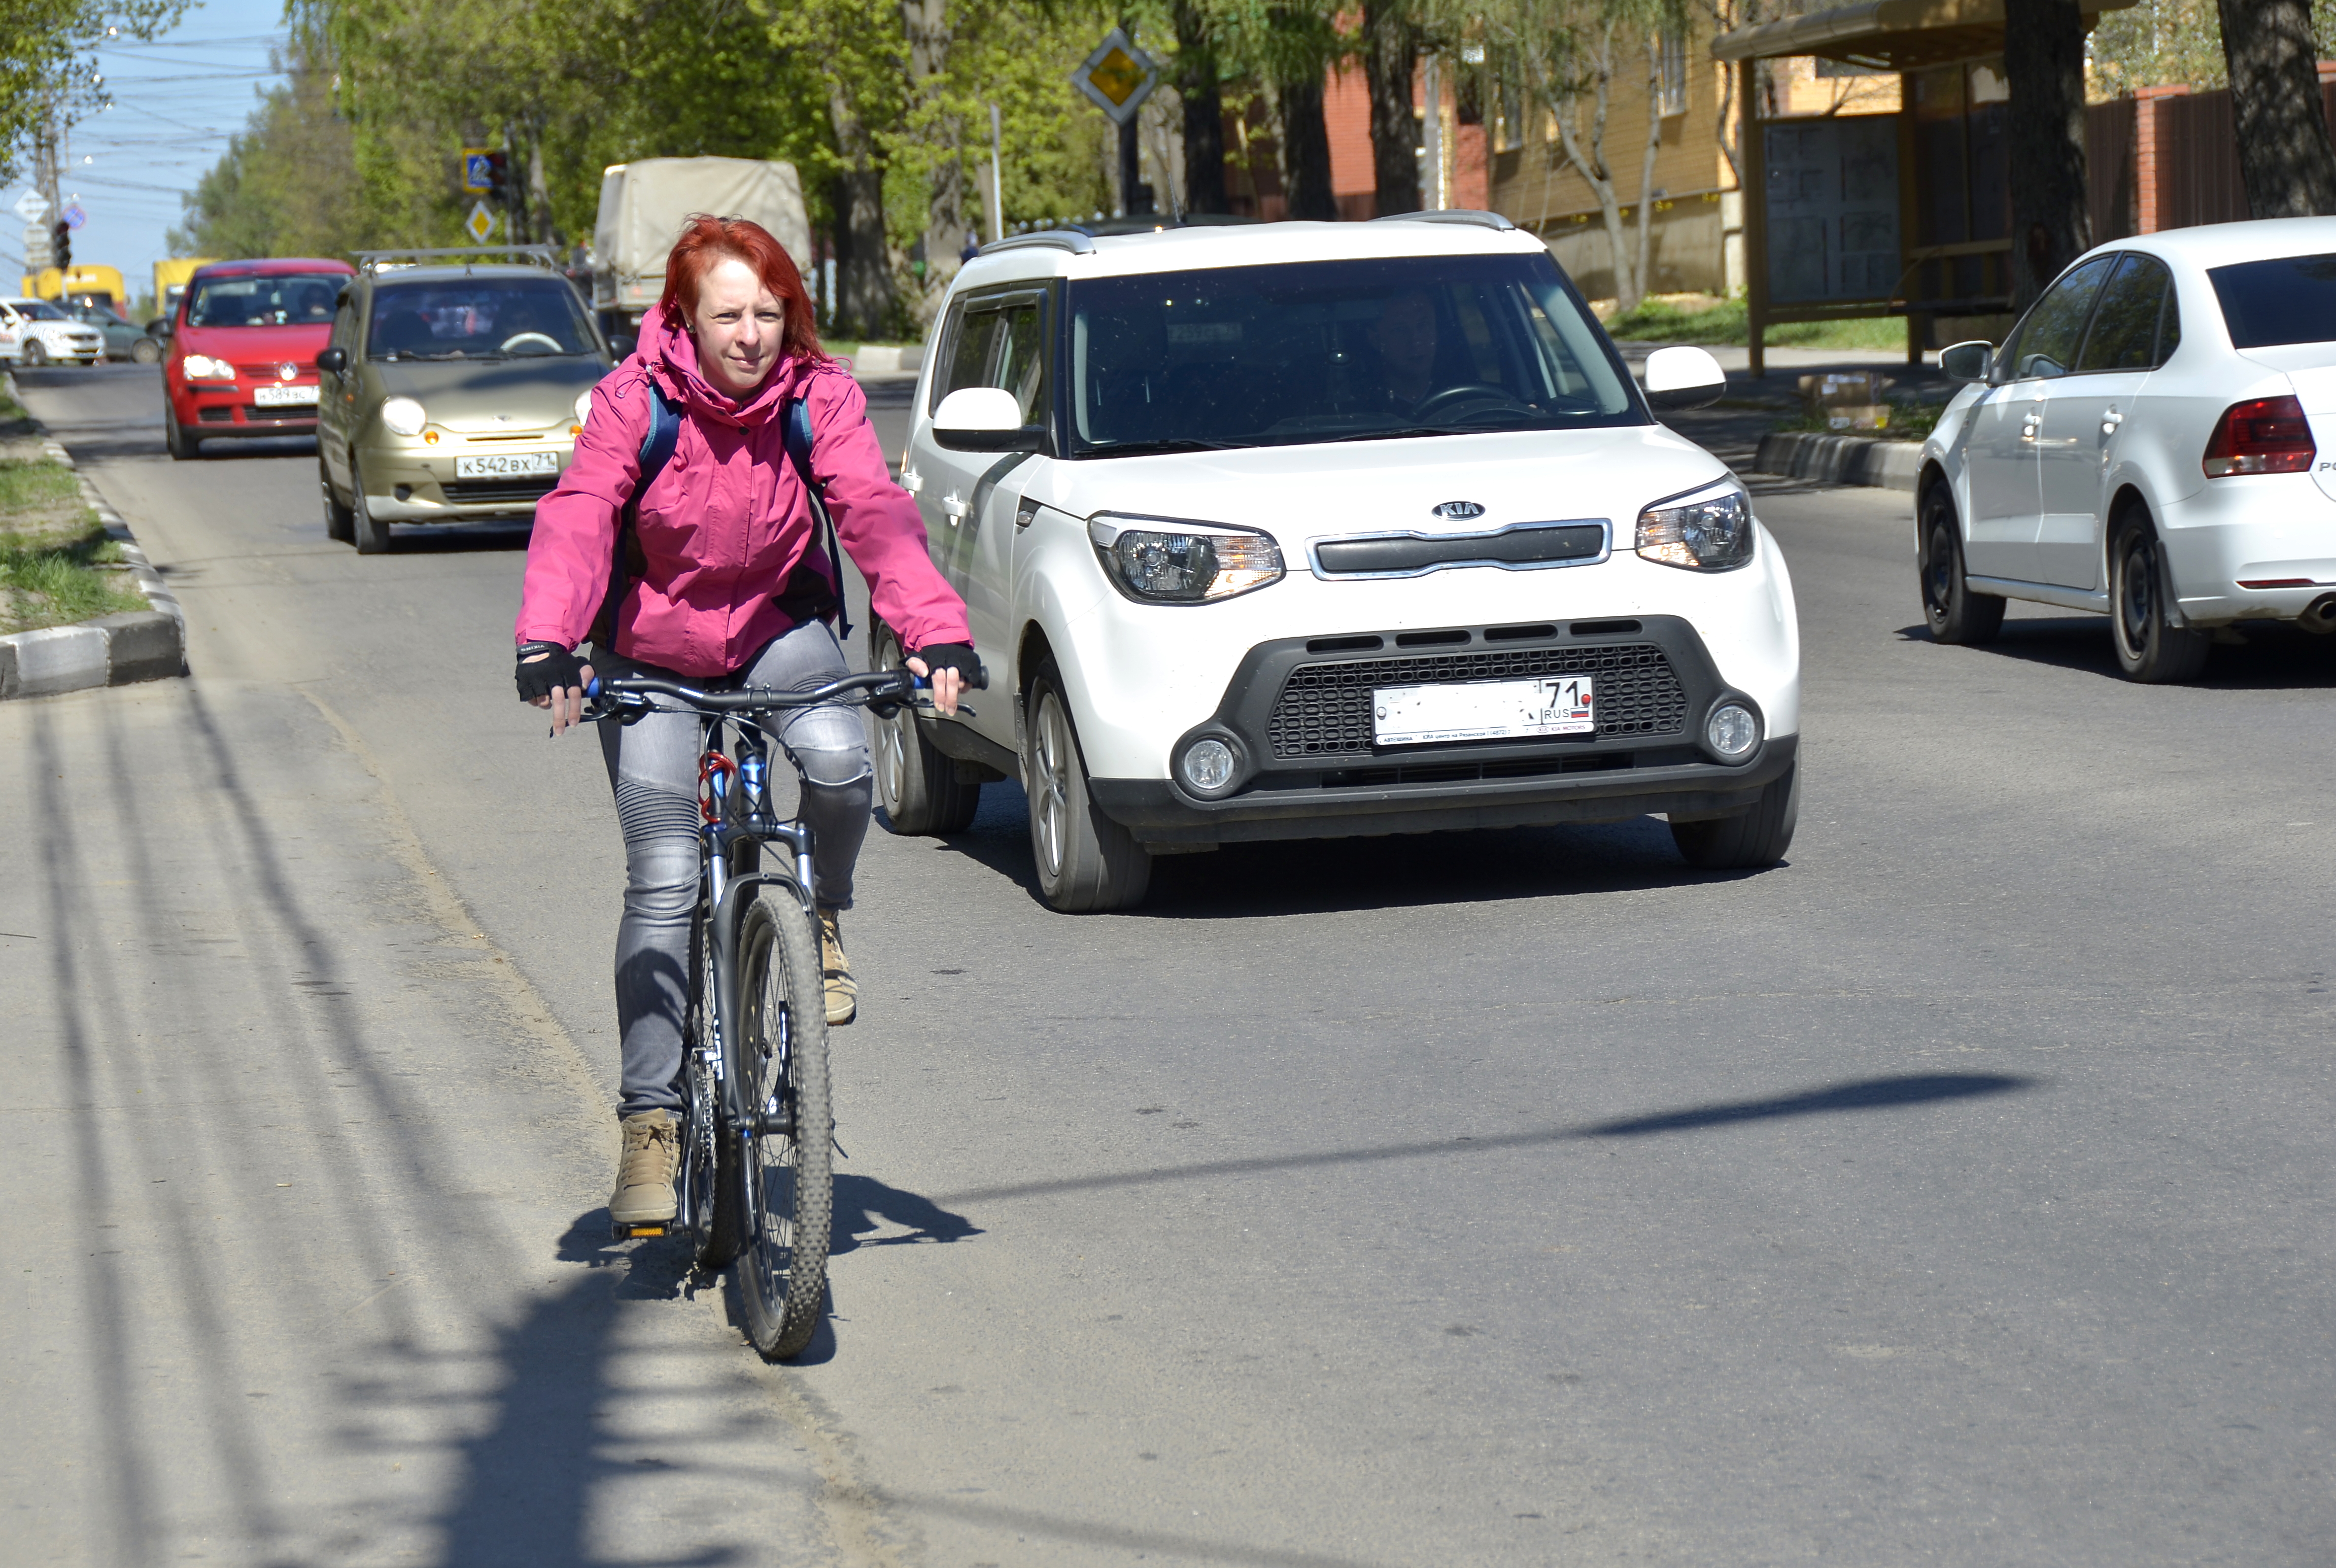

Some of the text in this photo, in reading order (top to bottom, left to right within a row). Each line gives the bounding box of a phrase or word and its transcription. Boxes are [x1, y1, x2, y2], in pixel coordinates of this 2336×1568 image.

[534, 454, 551, 465] 71
[1439, 502, 1480, 515] KIA
[1545, 681, 1579, 708] 71
[1544, 708, 1570, 719] RUS
